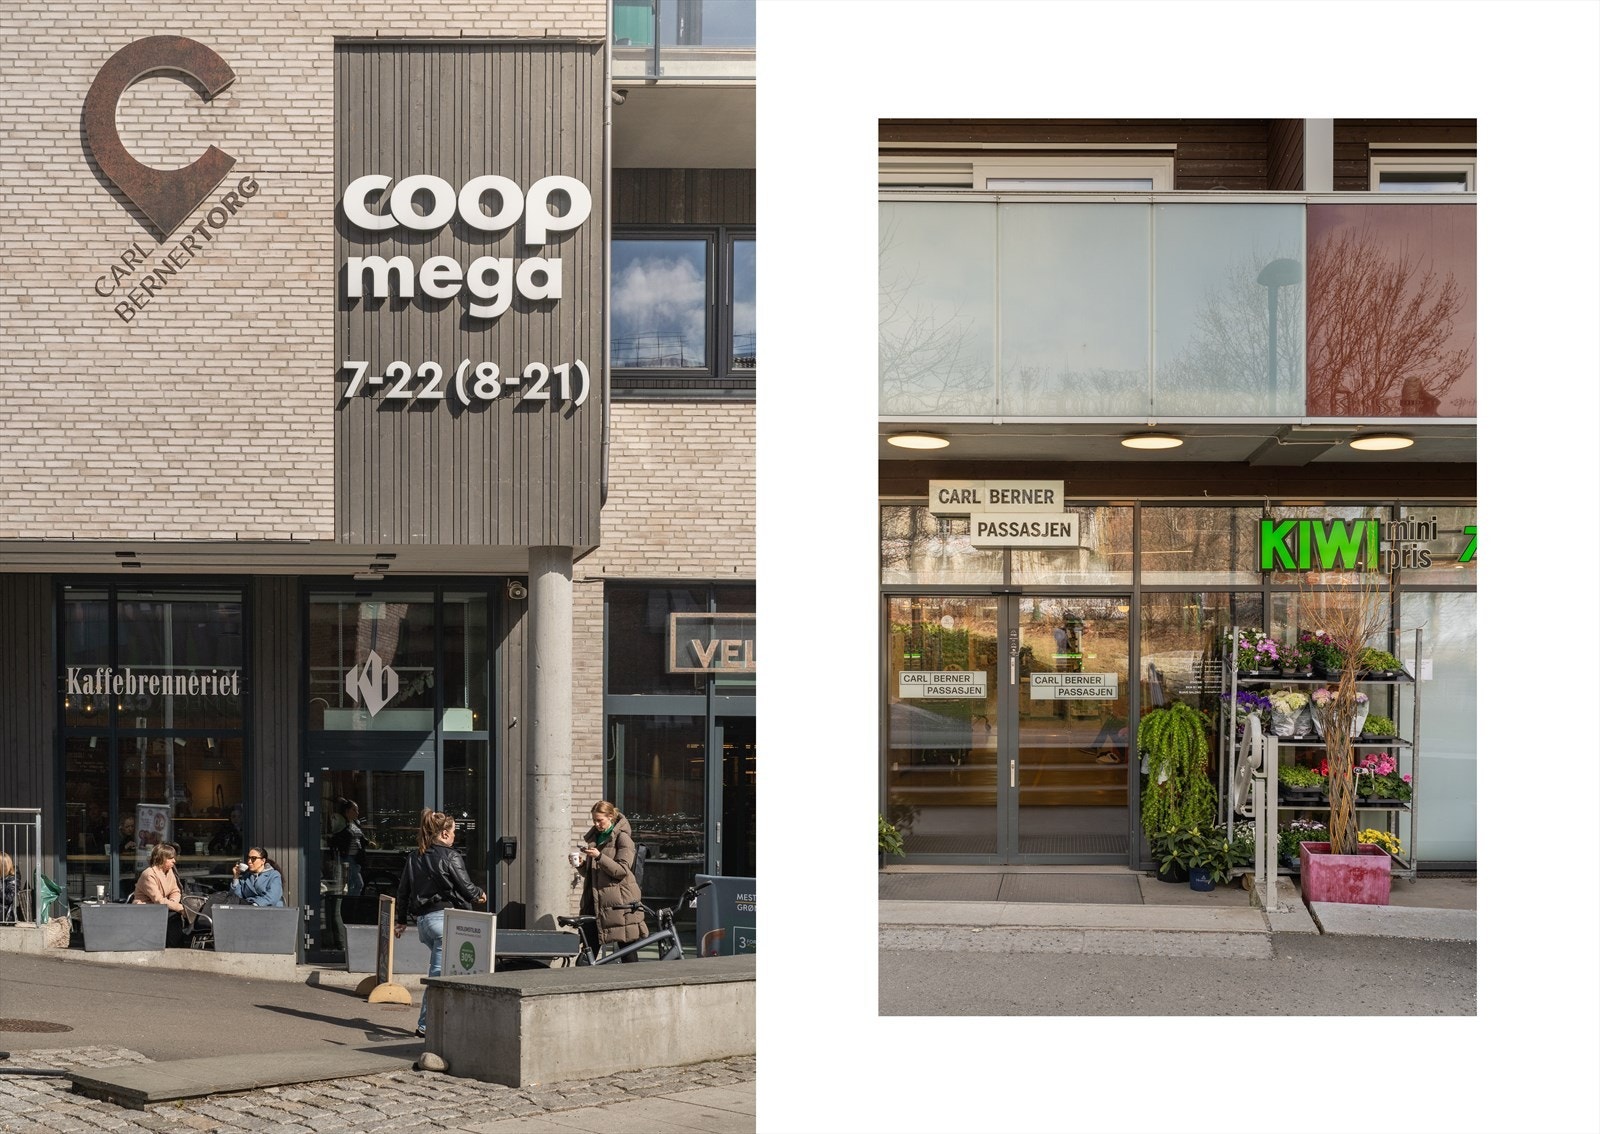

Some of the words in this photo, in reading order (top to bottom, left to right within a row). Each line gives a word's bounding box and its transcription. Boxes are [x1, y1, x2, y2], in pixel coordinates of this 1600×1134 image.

[343, 174, 592, 245] coop
[114, 176, 260, 324] BERNERTORG
[95, 242, 154, 297] CARL
[347, 255, 562, 319] mega
[343, 360, 444, 399] 7-22
[455, 358, 590, 407] (8-21)
[938, 488, 981, 504] CARL
[989, 488, 1055, 504] BERNER
[977, 521, 1072, 538] PASSASJEN
[1385, 515, 1438, 541] mini
[1259, 517, 1381, 570] KIWI
[1383, 543, 1433, 574] pris
[66, 667, 240, 697] Kaffebrenneriet
[903, 674, 928, 684] CARL
[933, 674, 971, 684] BERNER
[927, 686, 982, 695] PASSASJEN
[1034, 676, 1060, 685] CARL
[1064, 676, 1102, 685] BERNER
[1058, 687, 1113, 697] PASSASJEN
[739, 936, 747, 949] 3
